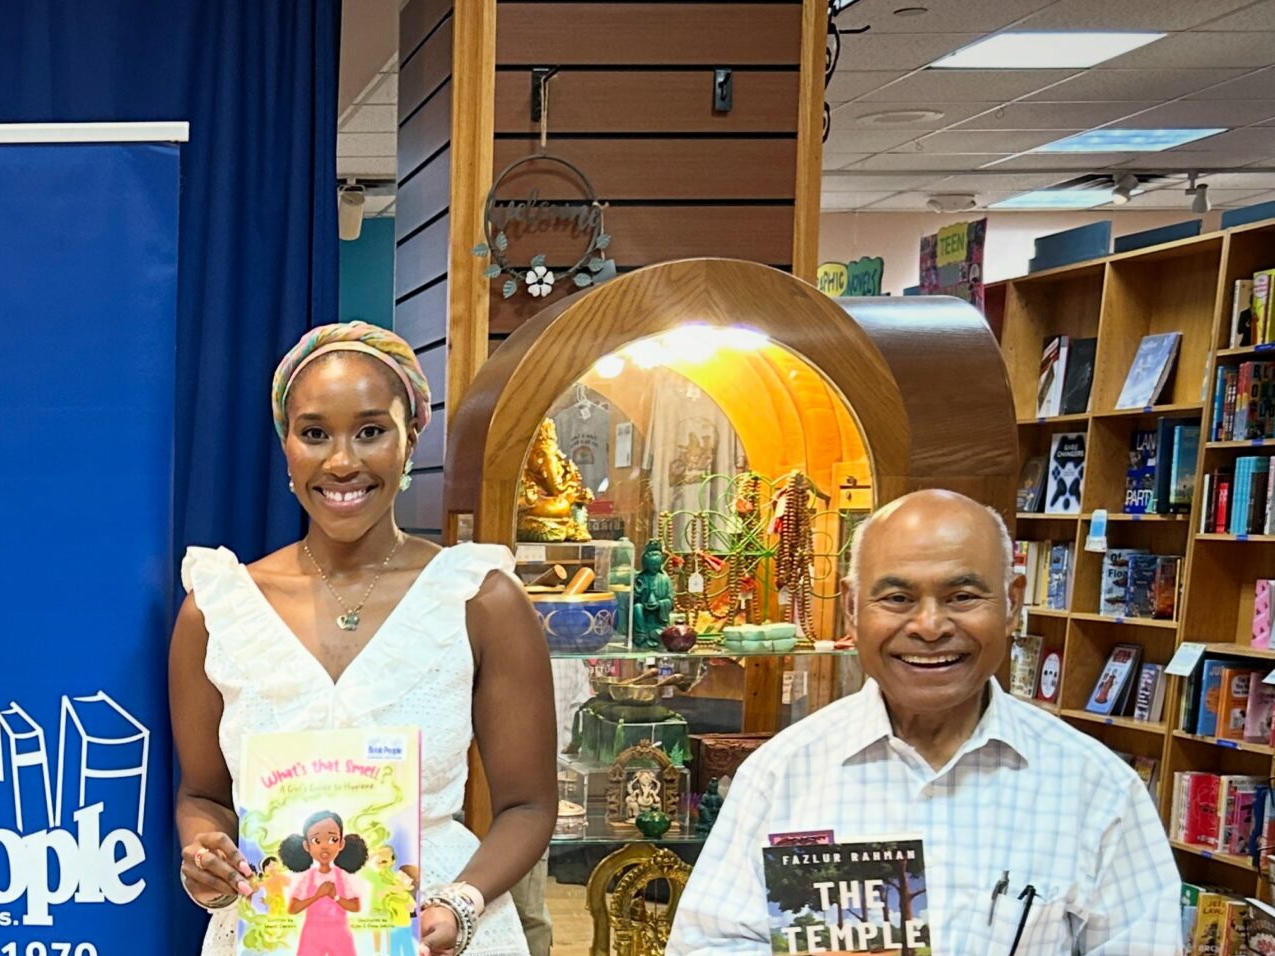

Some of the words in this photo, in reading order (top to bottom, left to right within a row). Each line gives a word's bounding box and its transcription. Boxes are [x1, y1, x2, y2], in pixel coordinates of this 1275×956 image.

[939, 232, 965, 256] TEEN
[261, 762, 307, 789] What's
[312, 758, 340, 773] that
[782, 852, 842, 866] FAZLUR
[850, 849, 916, 863] RAHMAN
[813, 879, 885, 911] THE
[781, 919, 926, 956] TEMPLE
